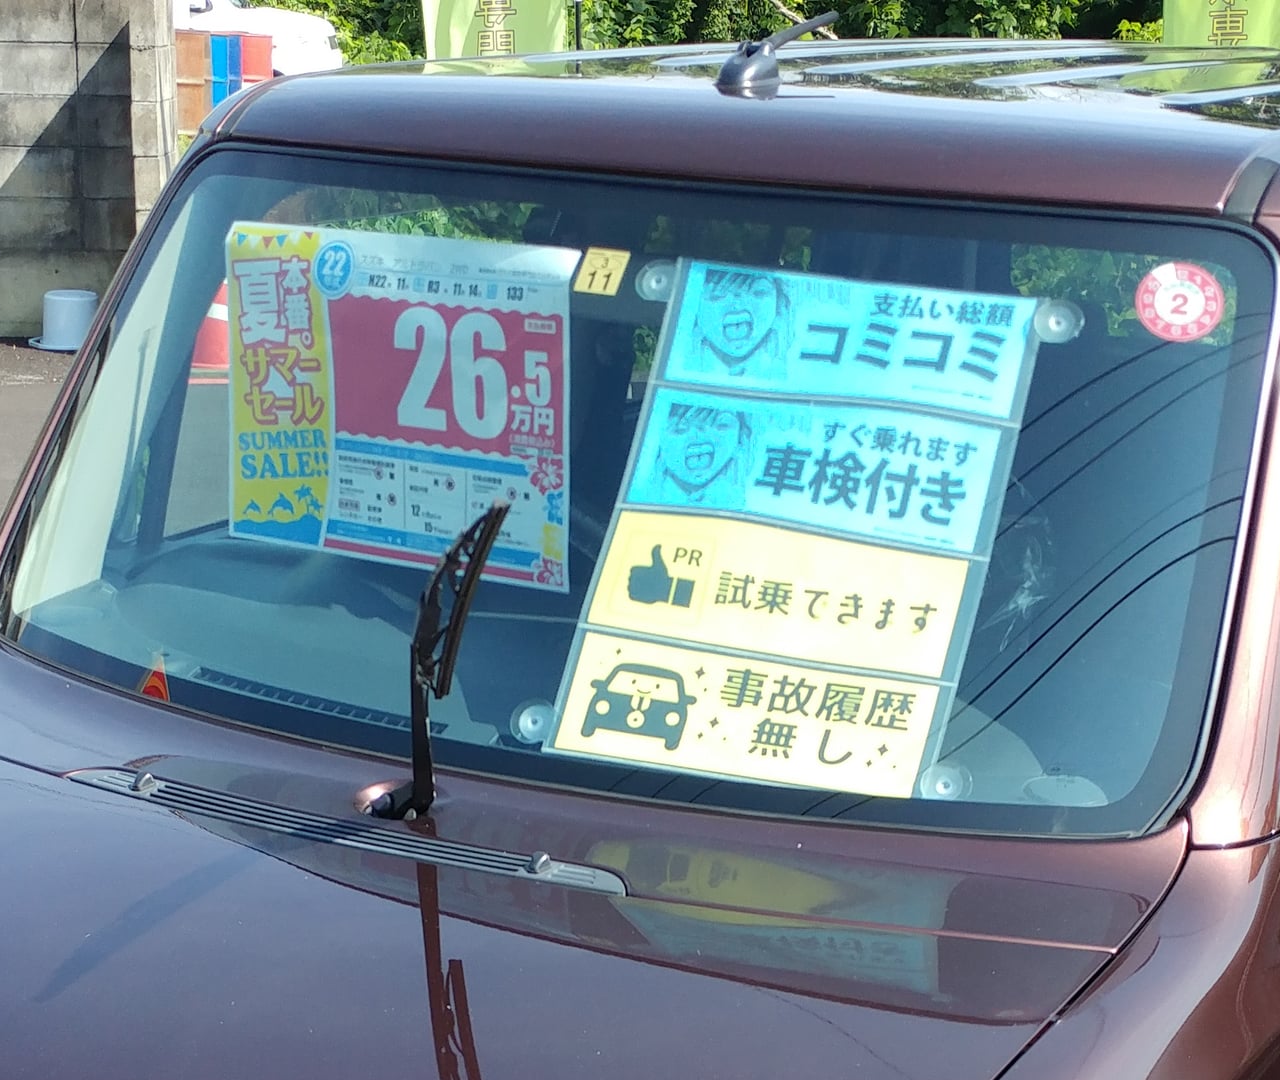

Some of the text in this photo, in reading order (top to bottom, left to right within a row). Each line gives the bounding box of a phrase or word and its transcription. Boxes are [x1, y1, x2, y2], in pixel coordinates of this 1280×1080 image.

[322, 250, 347, 277] 22
[587, 270, 612, 291] 11
[870, 293, 1016, 327] 支払い総額
[1170, 293, 1188, 315] 2
[241, 348, 321, 384] サマー
[799, 322, 1006, 383] コミコミ
[245, 384, 324, 424] セール
[238, 429, 326, 450] SUMMER
[823, 421, 978, 467] すぐ乗れます
[754, 441, 967, 527] 車検付き
[672, 546, 703, 567] PR
[714, 571, 938, 634] 試乗できます
[720, 668, 917, 731] 事故履歴
[747, 717, 852, 766] 無し
